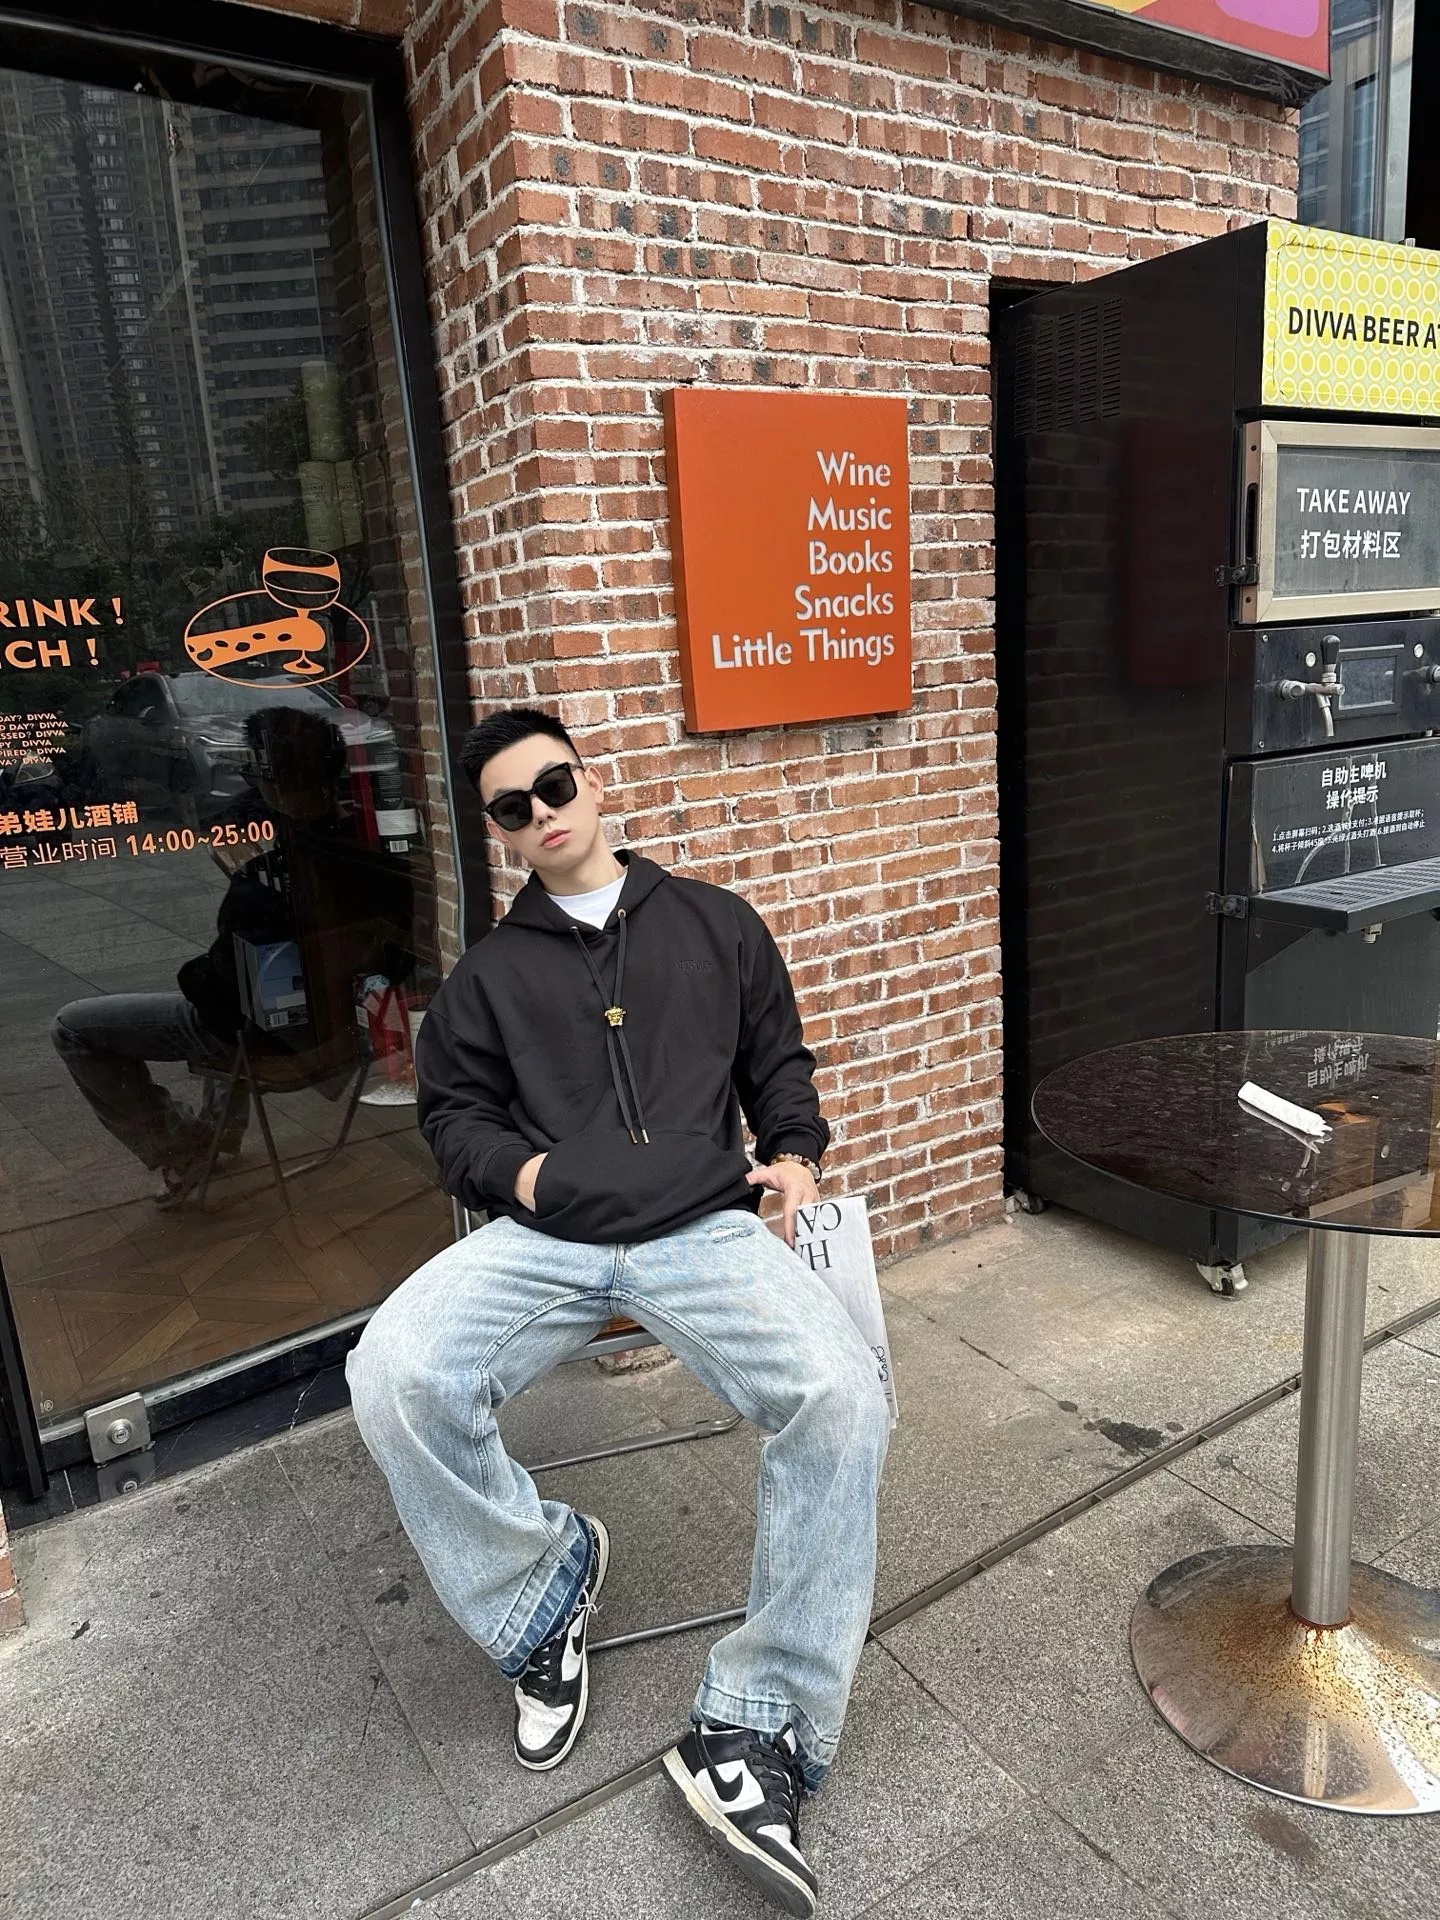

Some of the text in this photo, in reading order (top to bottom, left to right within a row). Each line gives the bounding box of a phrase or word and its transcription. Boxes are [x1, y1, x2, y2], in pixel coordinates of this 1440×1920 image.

[1288, 306, 1440, 349] DIVVA BEER A
[816, 450, 891, 487] Wine
[807, 496, 892, 531] Music
[1296, 487, 1411, 515] TAKE AWAY
[809, 540, 893, 575] Books
[1300, 529, 1401, 559] 打包材料区
[795, 582, 894, 620] Snacks
[0, 639, 71, 669] CH
[712, 627, 895, 669] Little Things
[9, 723, 35, 731] DAY?
[39, 721, 69, 729] DIVVA
[27, 713, 57, 721] DIVVA
[0, 729, 65, 740] SSED? DIVVA
[22, 740, 52, 748] DIVVA
[22, 757, 53, 765] DIVVA
[37, 747, 67, 755] DIVVA
[1322, 761, 1387, 788] 自助生啤机
[1326, 785, 1379, 810] 操作提示
[0, 820, 275, 870] 营业时间 14:00~25:00
[796, 1202, 842, 1237] CA
